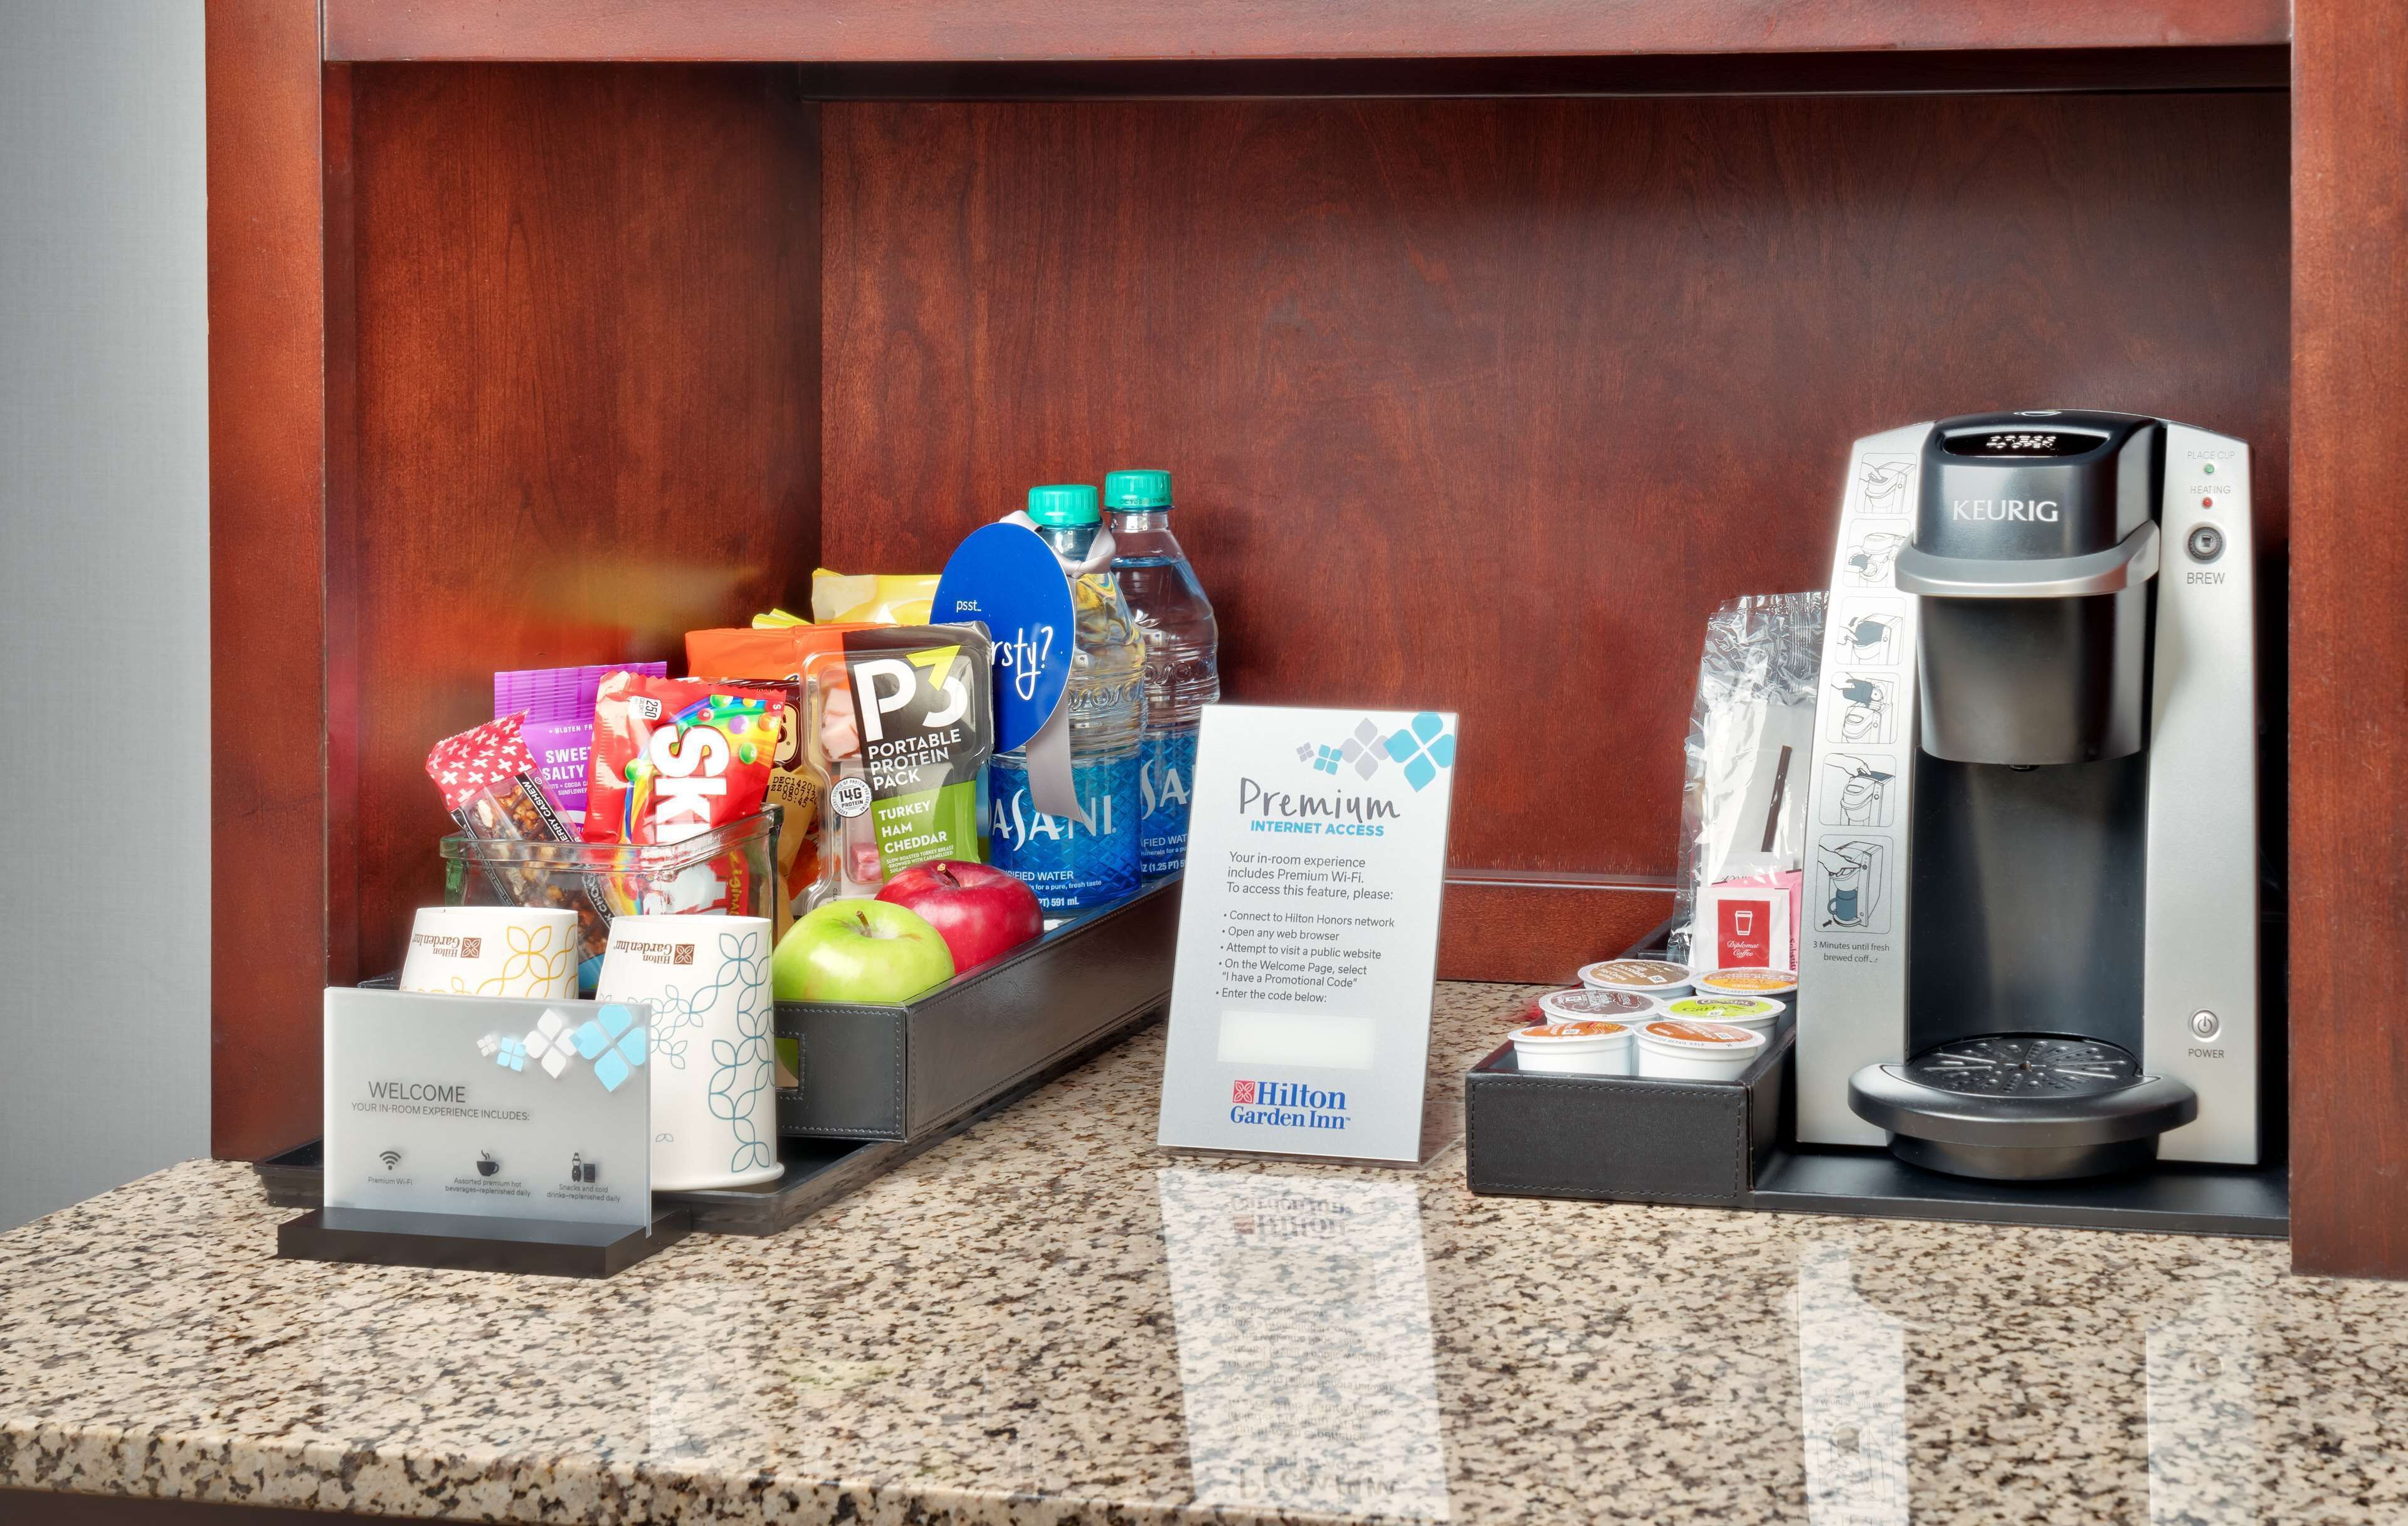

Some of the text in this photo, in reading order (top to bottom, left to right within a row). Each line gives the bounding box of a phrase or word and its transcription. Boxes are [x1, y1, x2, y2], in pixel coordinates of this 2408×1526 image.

[2187, 451, 2235, 459] PLACE CUP
[2190, 485, 2231, 494] HEATING
[1953, 501, 2059, 522] KEURIG
[2187, 573, 2226, 585] BREW
[853, 644, 968, 742] P3
[646, 701, 658, 719] 250
[554, 725, 581, 733] GLUTEN
[867, 728, 961, 760] PORTABLE
[870, 746, 949, 775] PROTEIN
[542, 764, 584, 781] SALTY
[873, 768, 921, 791] PACK
[522, 781, 552, 817] CASHEW
[839, 787, 862, 802] 14G
[1240, 777, 1400, 823] Premium
[842, 800, 863, 808] PROTEIN
[879, 800, 931, 821] TURKEY
[988, 789, 1112, 851] ASANI
[549, 818, 569, 842] ERRY
[882, 822, 912, 837] HAM
[1250, 820, 1384, 837] INTERNET ACCESS
[884, 831, 948, 854] CHEDDAR
[1149, 862, 1166, 872] (1.25
[1168, 860, 1179, 870] PT)
[1230, 852, 1366, 869] Your in-room experience
[1037, 871, 1074, 881] WATER
[1228, 867, 1364, 883] includes Premium Wi-Fi.
[1227, 882, 1393, 902] To access this feature, please:
[1052, 898, 1064, 907] 591
[1067, 896, 1079, 906] mL
[1230, 911, 1395, 928] Connect to Hilton Honors network
[423, 935, 460, 948] Garden
[1228, 927, 1339, 941] Open any web browser
[631, 942, 672, 955] Garden
[1227, 943, 1265, 956] Attempt
[1269, 945, 1278, 954] to
[1281, 946, 1300, 956] visit
[1311, 946, 1341, 960] public
[1343, 948, 1381, 959] website
[1727, 940, 1760, 949] Diplomat
[433, 948, 458, 957] Hilton
[643, 954, 671, 964] Hilton
[1733, 949, 1754, 958] Coffee
[1824, 953, 1852, 962] brewed
[1225, 959, 1367, 975] On the Welcome Page, select
[1232, 973, 1254, 983] have
[1265, 974, 1324, 987] Promotional
[1222, 988, 1327, 1003] Enter the code below:
[2189, 1048, 2224, 1059] POWER
[368, 1081, 466, 1103] WELCOME
[1255, 1081, 1346, 1110] Hilton
[352, 1102, 529, 1121] YOUR IN-ROOM EXPERIENCE INCLUDES:
[1230, 1106, 1306, 1126] Garden
[368, 1177, 395, 1185] Premium
[454, 1177, 482, 1185] Assorted
[559, 1184, 581, 1192] Snacks
[517, 1189, 531, 1197] daily
[606, 1195, 621, 1203] daily
